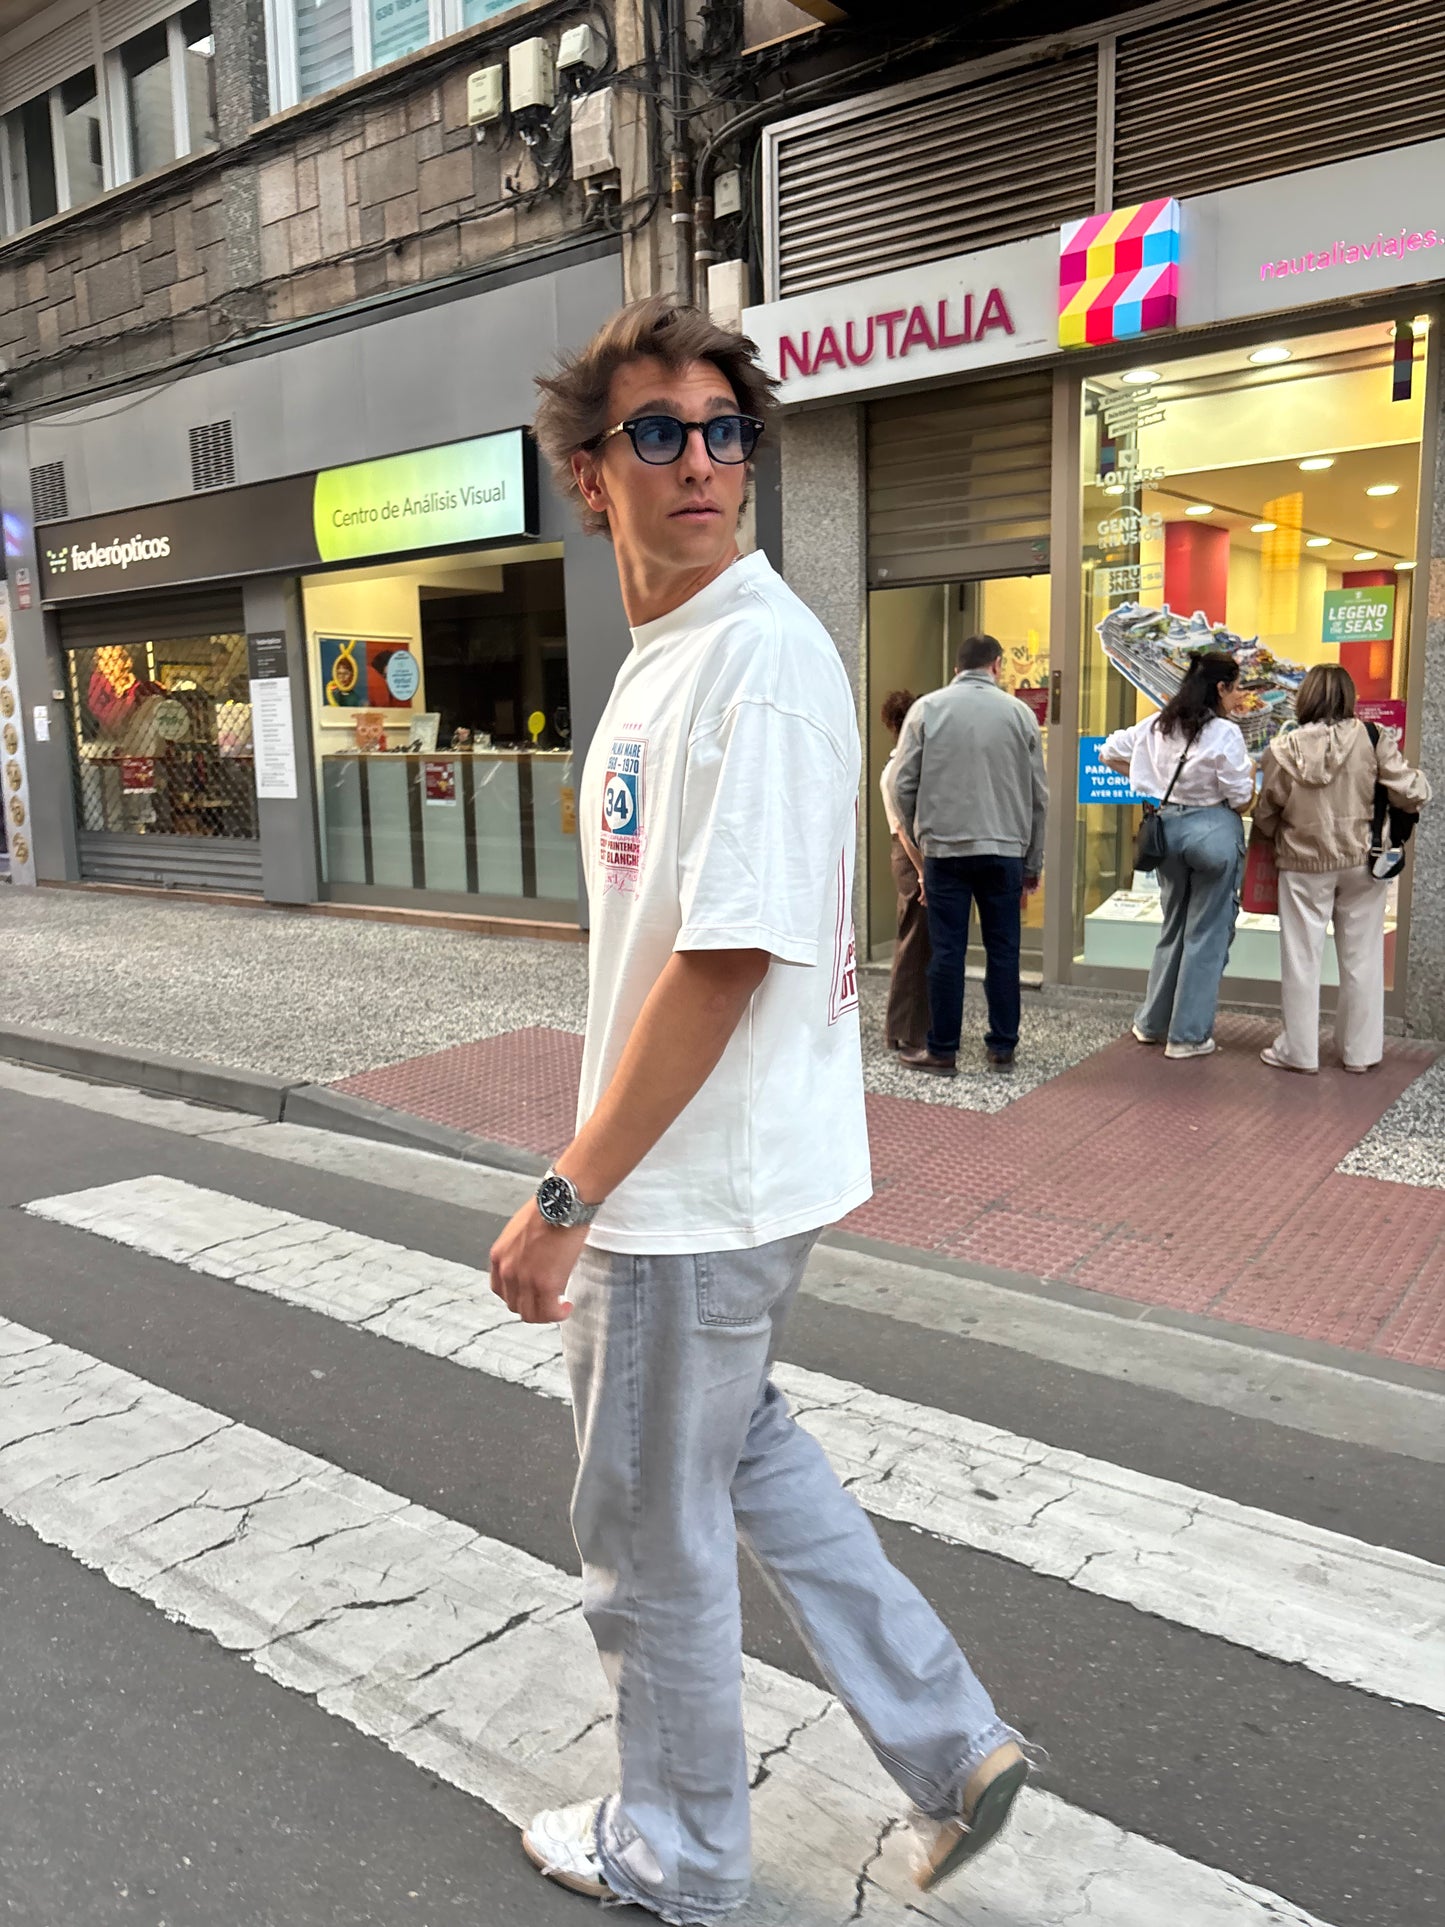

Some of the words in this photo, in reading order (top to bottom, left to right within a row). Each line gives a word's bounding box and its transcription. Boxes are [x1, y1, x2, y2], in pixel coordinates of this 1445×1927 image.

[779, 287, 1016, 381] NAUTALIA
[1096, 466, 1165, 487] LOVERS
[332, 508, 379, 528] Centro
[381, 501, 400, 521] de
[402, 491, 458, 517] Análisis
[460, 480, 506, 507] Visual
[71, 533, 171, 571] federópticos
[1329, 604, 1388, 620] LEGEND
[1344, 618, 1384, 634] SEAS
[622, 758, 640, 774] 1970
[1085, 764, 1113, 774] PARA
[1091, 776, 1105, 786] TU
[1090, 790, 1111, 798] AYER
[605, 787, 629, 820] 34
